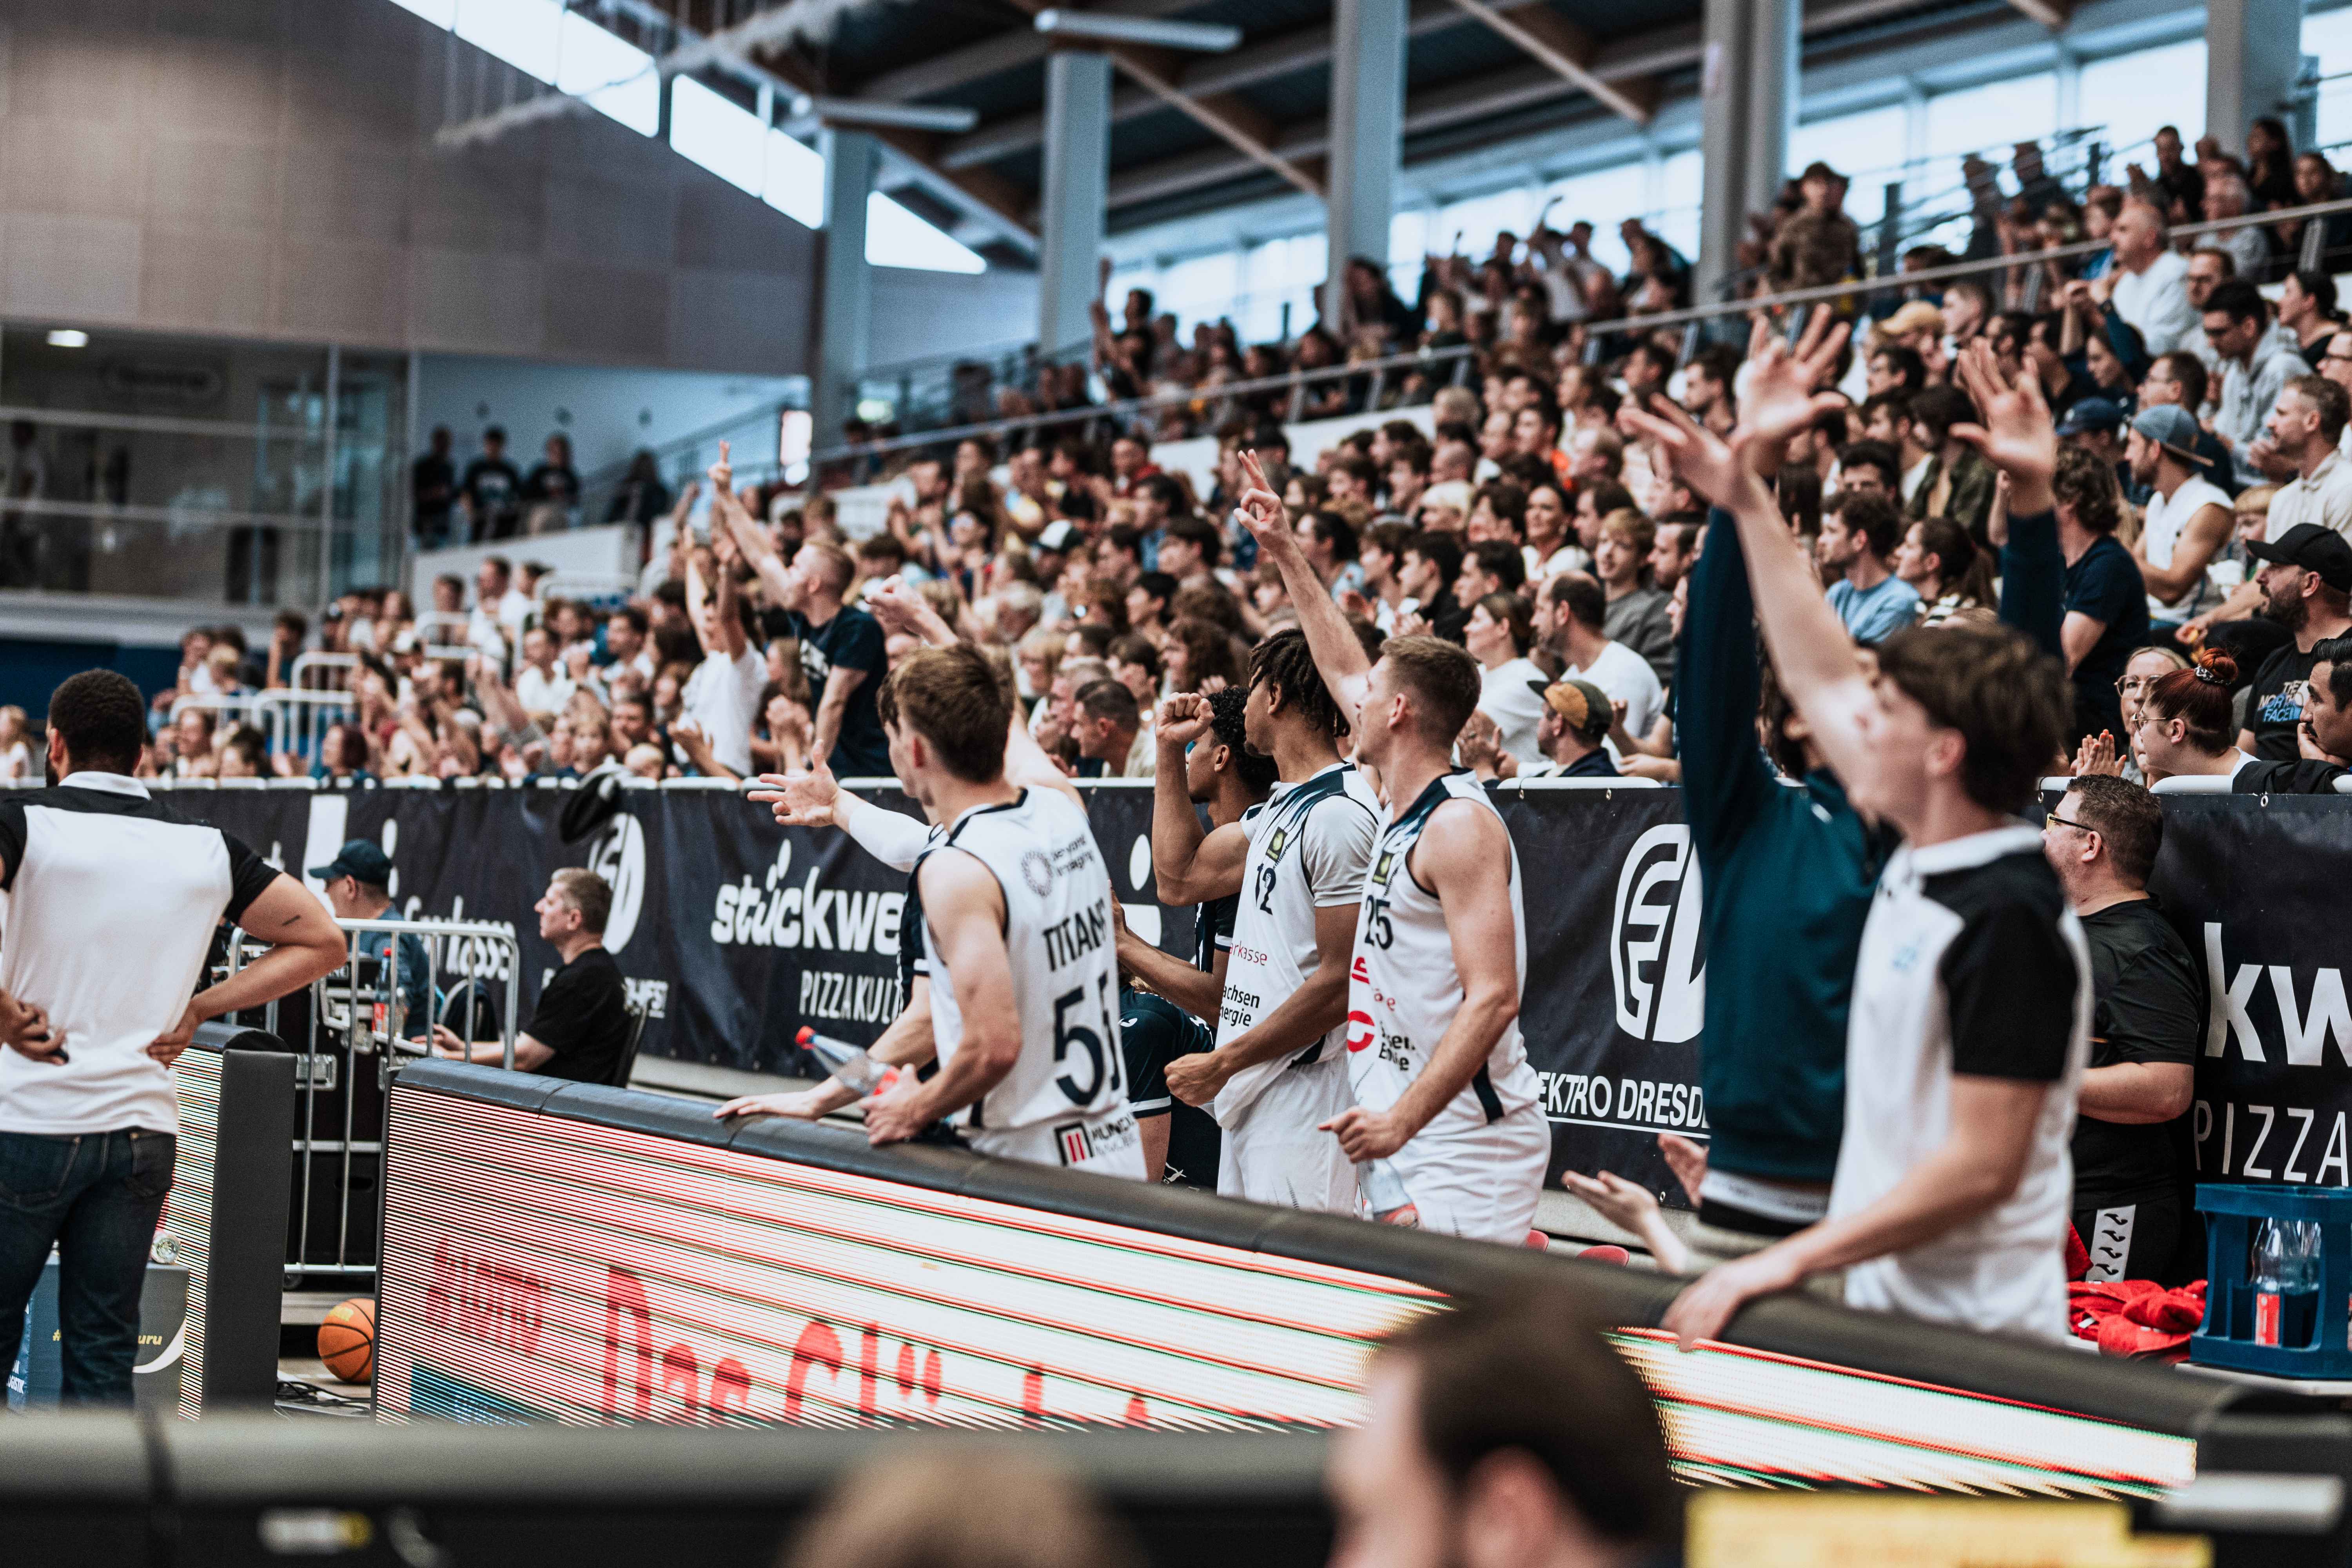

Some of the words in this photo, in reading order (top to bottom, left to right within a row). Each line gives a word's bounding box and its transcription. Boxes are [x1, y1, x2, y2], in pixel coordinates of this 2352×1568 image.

[2283, 680, 2302, 695] THE
[2263, 707, 2290, 722] FACE
[1255, 863, 1276, 916] 12
[1042, 898, 1107, 972] TITAN
[1364, 895, 1394, 950] 25
[2194, 1100, 2349, 1187] PIZZA
[7, 1375, 24, 1394] OGISTIK
